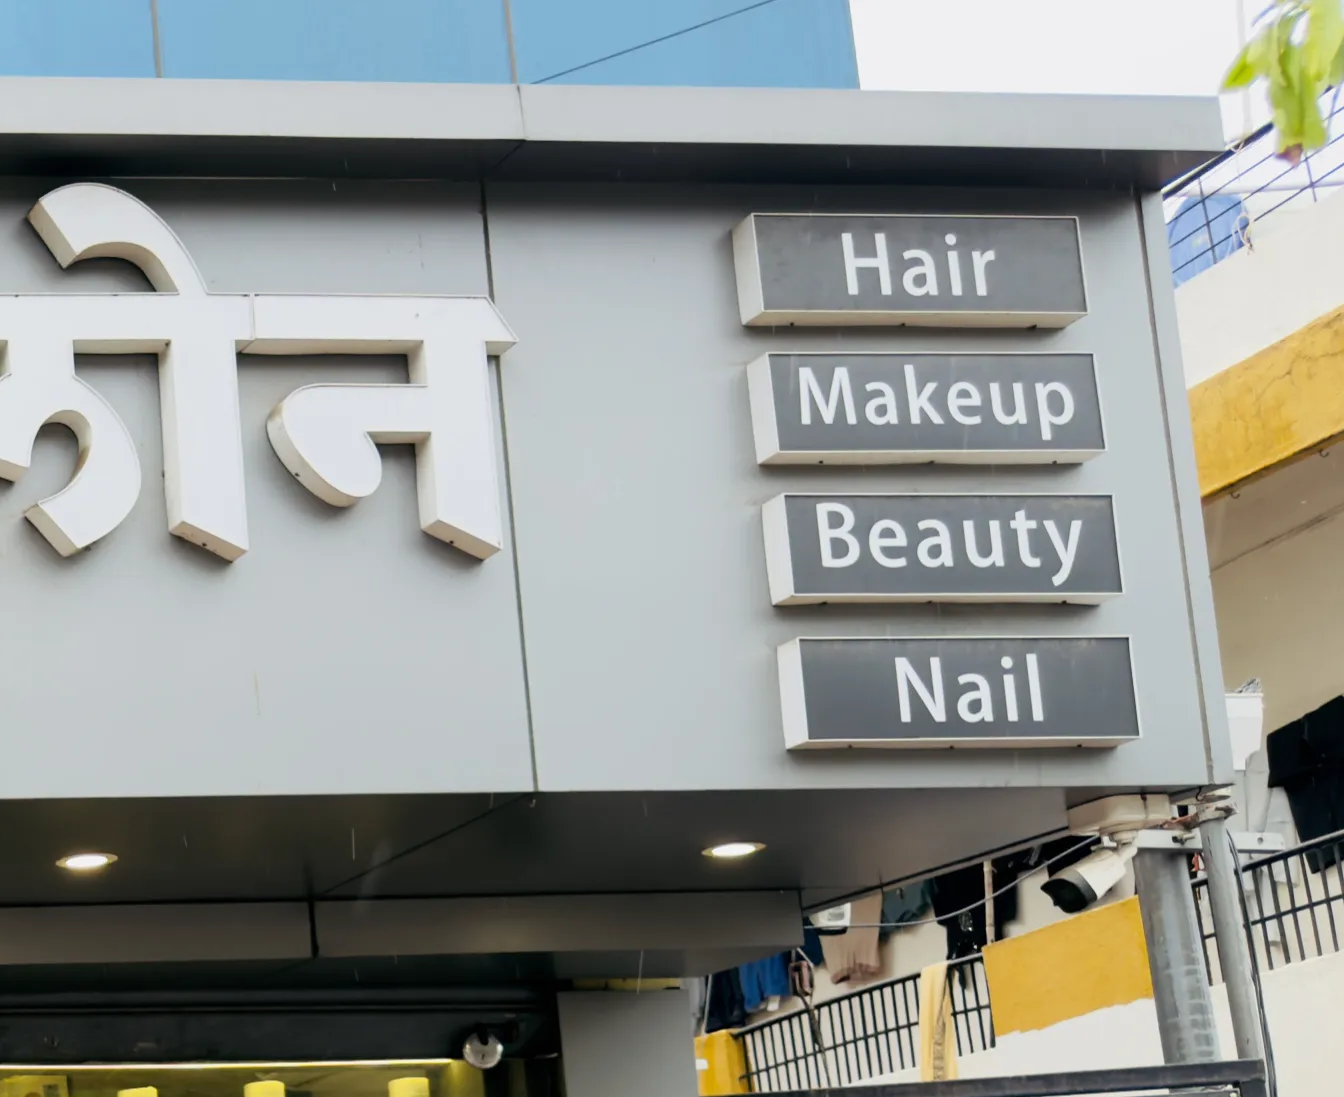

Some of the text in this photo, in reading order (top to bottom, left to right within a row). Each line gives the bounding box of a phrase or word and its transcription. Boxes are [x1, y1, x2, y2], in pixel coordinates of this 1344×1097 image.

[840, 232, 997, 297] Hair
[797, 363, 1076, 441] Makeup
[814, 501, 1083, 587] Beauty
[893, 652, 1046, 724] Nail
